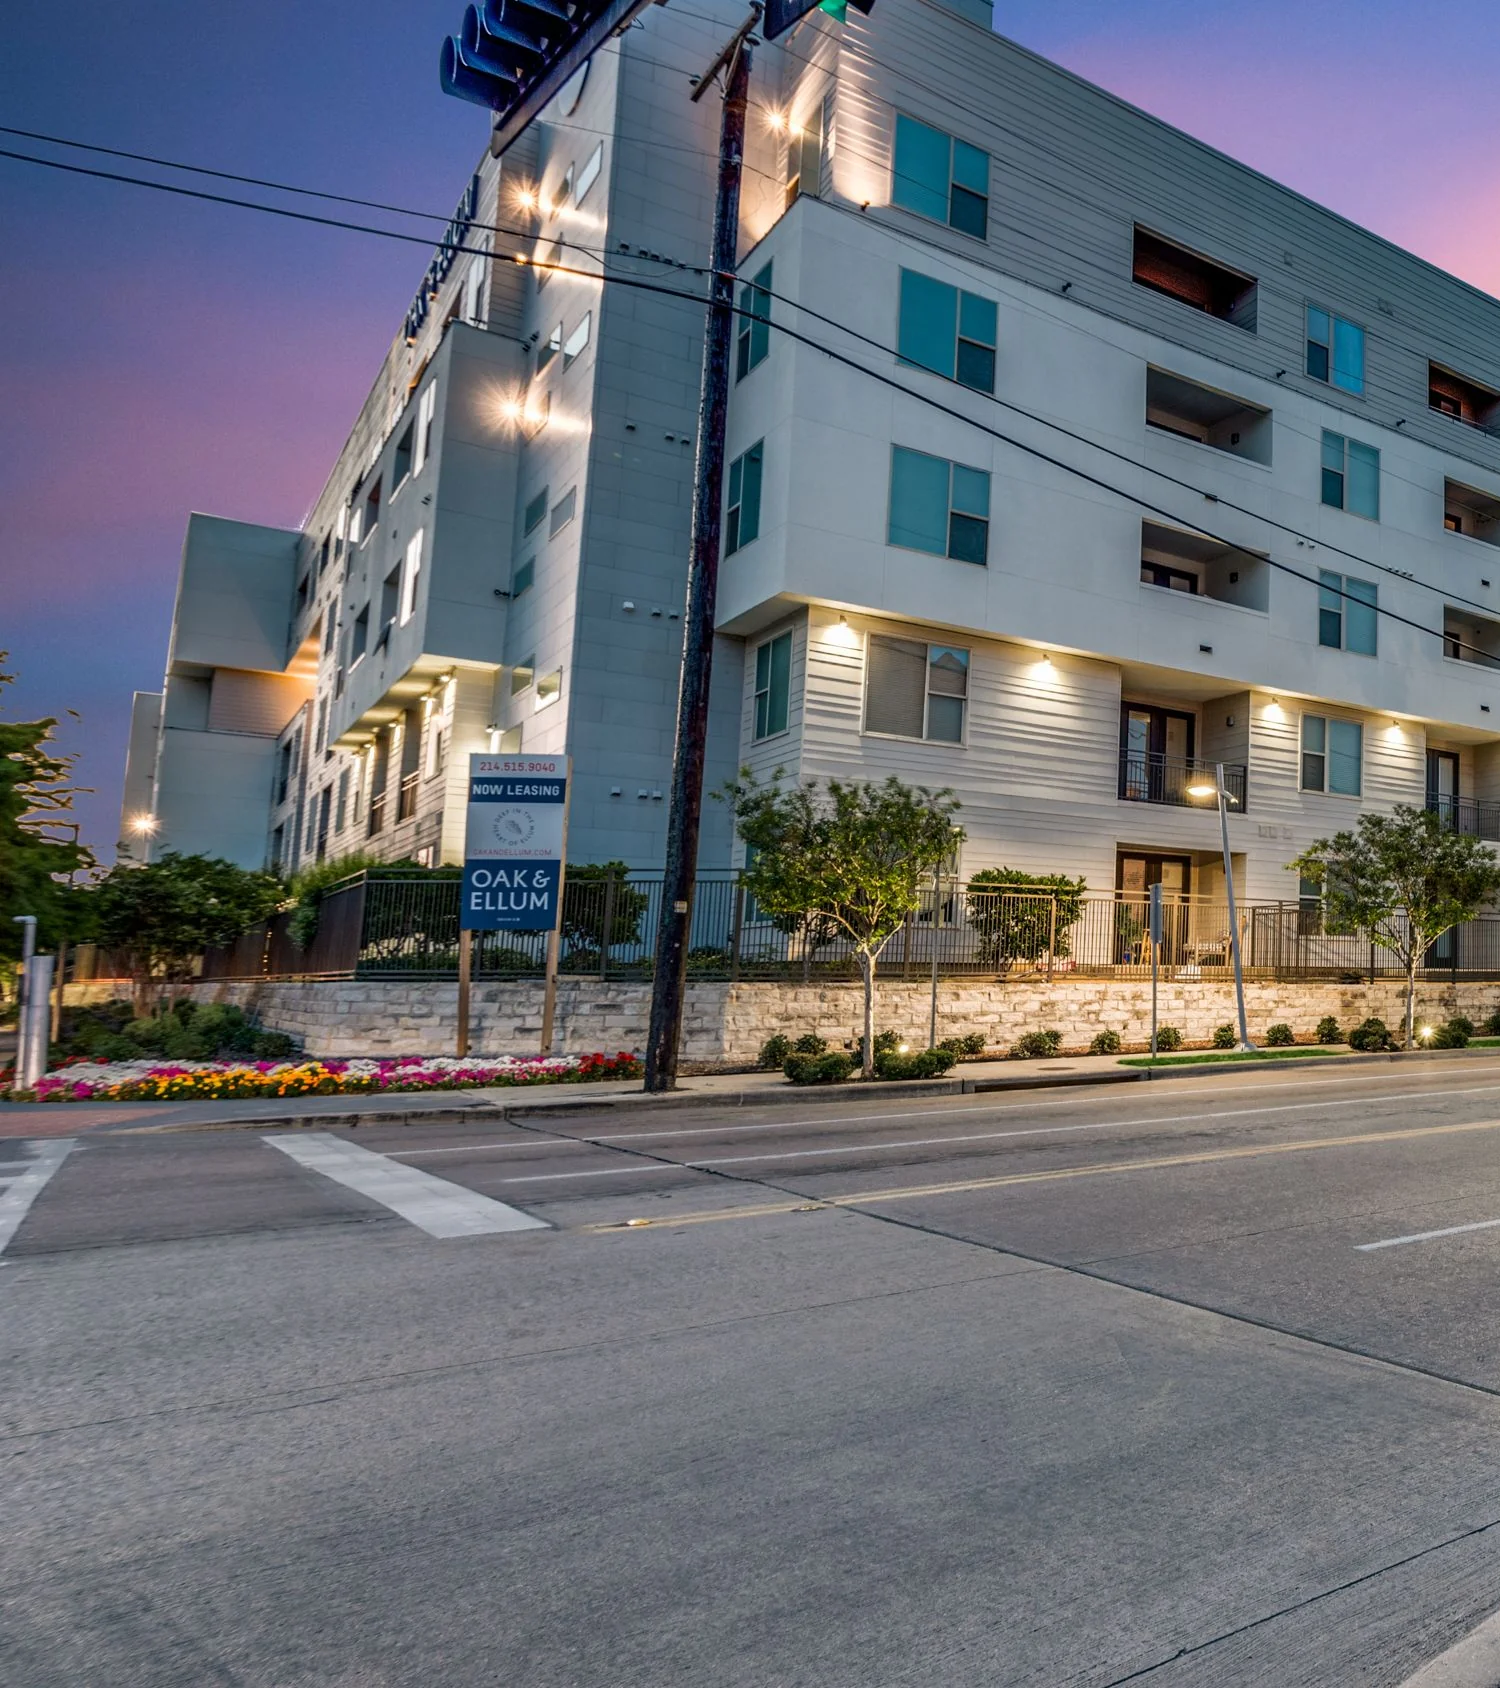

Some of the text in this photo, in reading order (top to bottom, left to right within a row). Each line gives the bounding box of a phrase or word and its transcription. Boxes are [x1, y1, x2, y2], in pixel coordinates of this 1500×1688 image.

[480, 761, 556, 772] 214.515.9040
[472, 784, 560, 796] NOW LEASING
[472, 848, 552, 856] OAKANDELLUM.COM
[471, 869, 551, 888] OAK &
[470, 892, 549, 910] ELLUM
